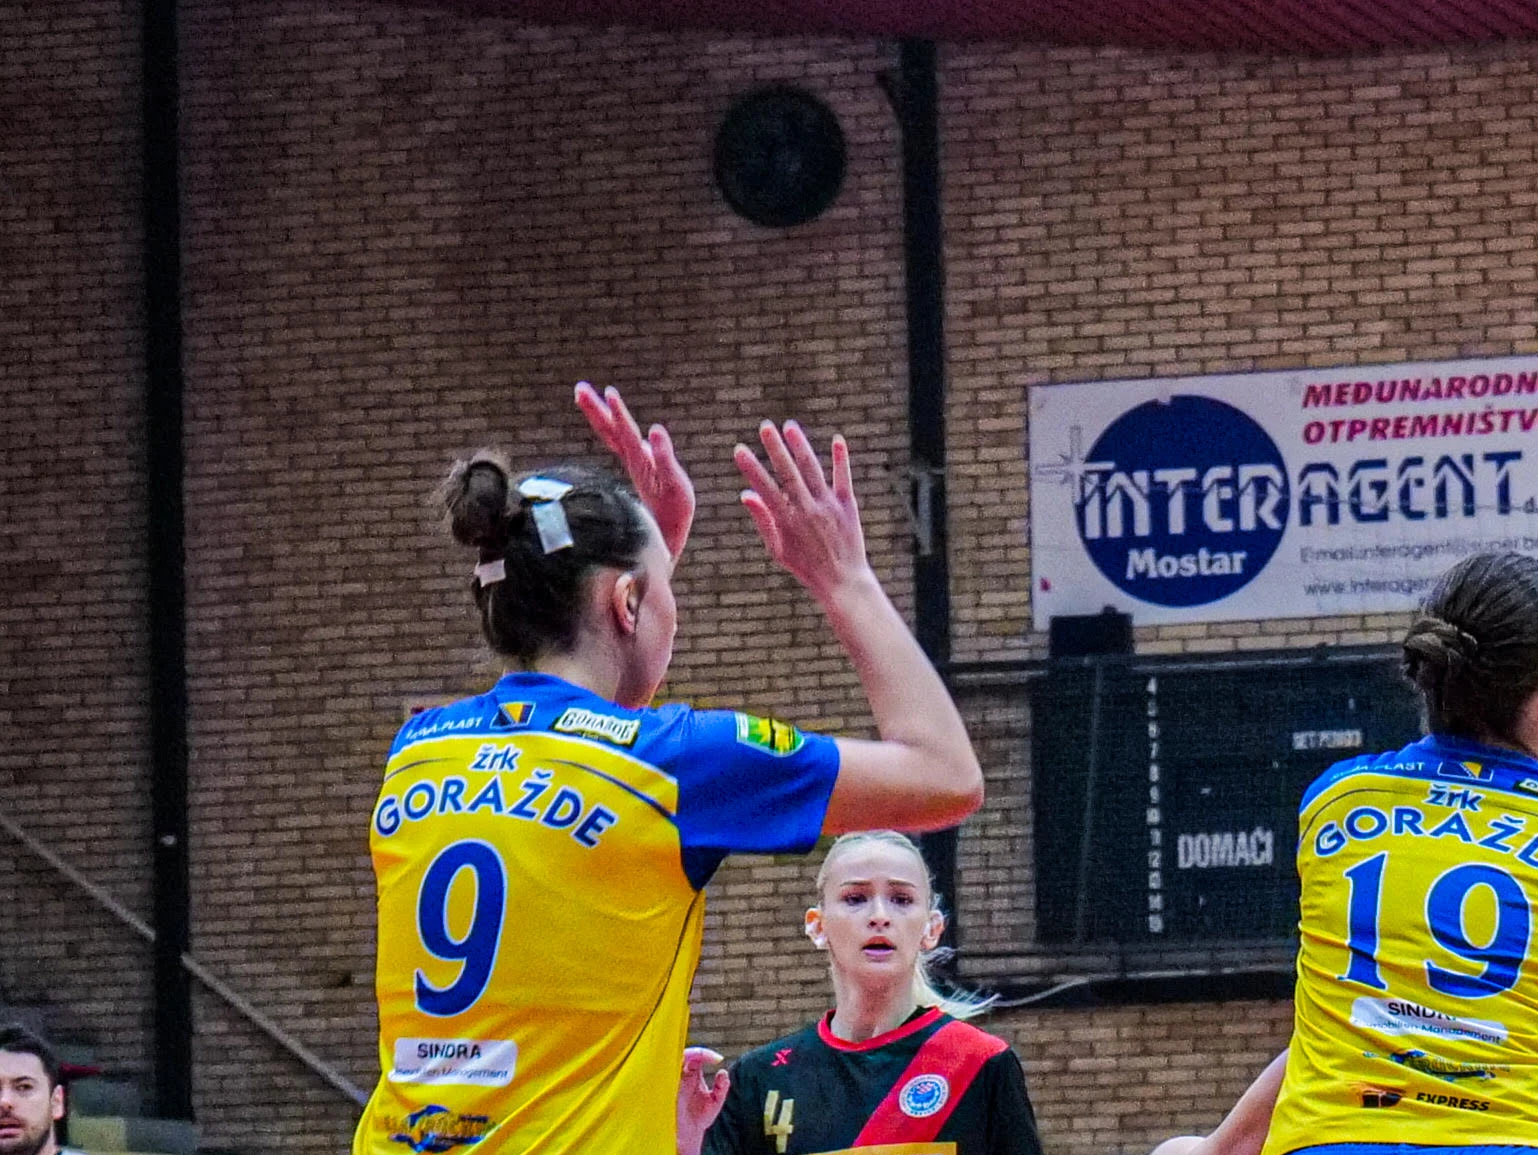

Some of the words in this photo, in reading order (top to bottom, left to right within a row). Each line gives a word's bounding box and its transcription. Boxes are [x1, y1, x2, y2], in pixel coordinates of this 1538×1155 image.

[1125, 547, 1247, 580] Mostar
[374, 770, 618, 849] GORAŽDE
[413, 838, 507, 1018] 9
[1336, 851, 1534, 999] 19
[417, 1043, 482, 1058] SINDRA
[764, 1090, 795, 1153] 4
[1416, 1093, 1490, 1111] EXPRESS
